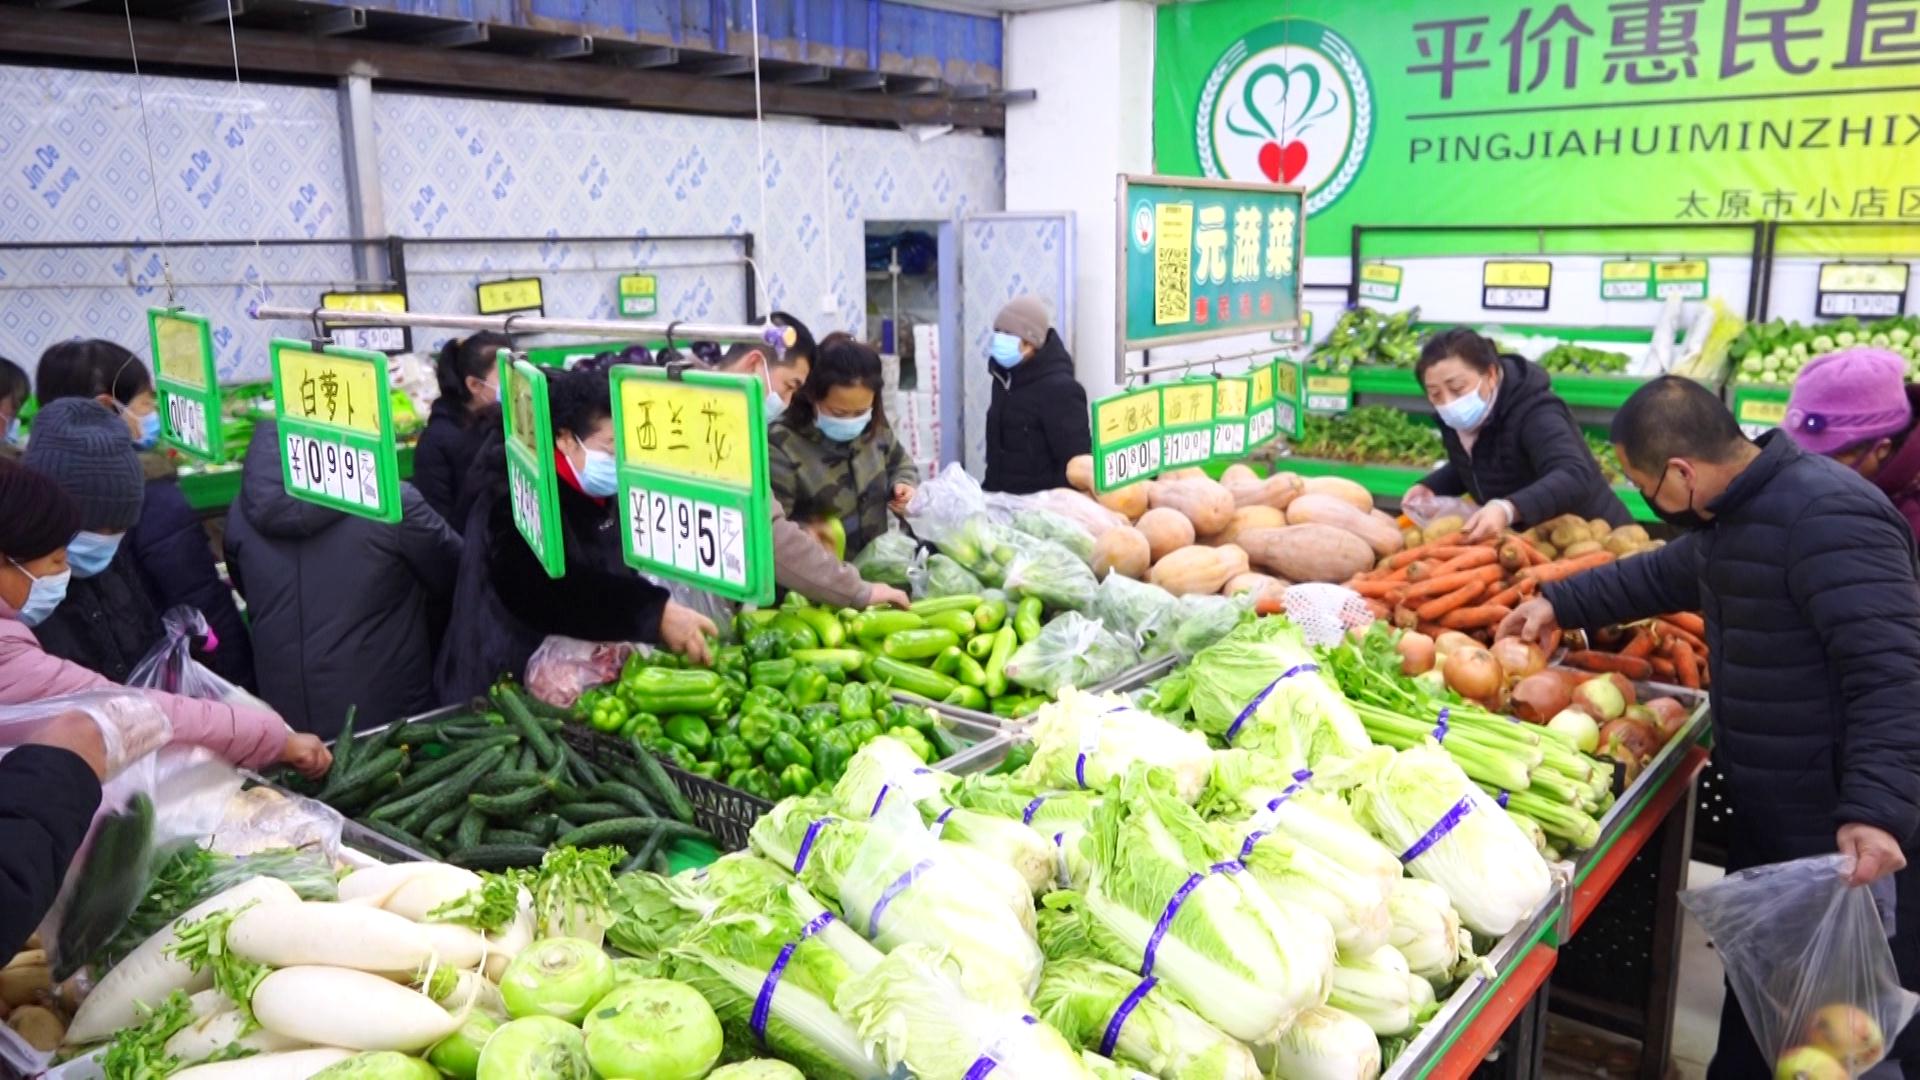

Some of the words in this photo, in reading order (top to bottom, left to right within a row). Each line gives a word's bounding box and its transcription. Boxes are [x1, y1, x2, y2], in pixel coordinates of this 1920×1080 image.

[22, 163, 46, 190] Jin
[35, 143, 60, 169] De
[1675, 186, 1920, 219] 太原市小店区
[1195, 205, 1297, 284] 元蔬菜
[301, 368, 355, 426] 白萝卜
[636, 398, 732, 471] 西兰花
